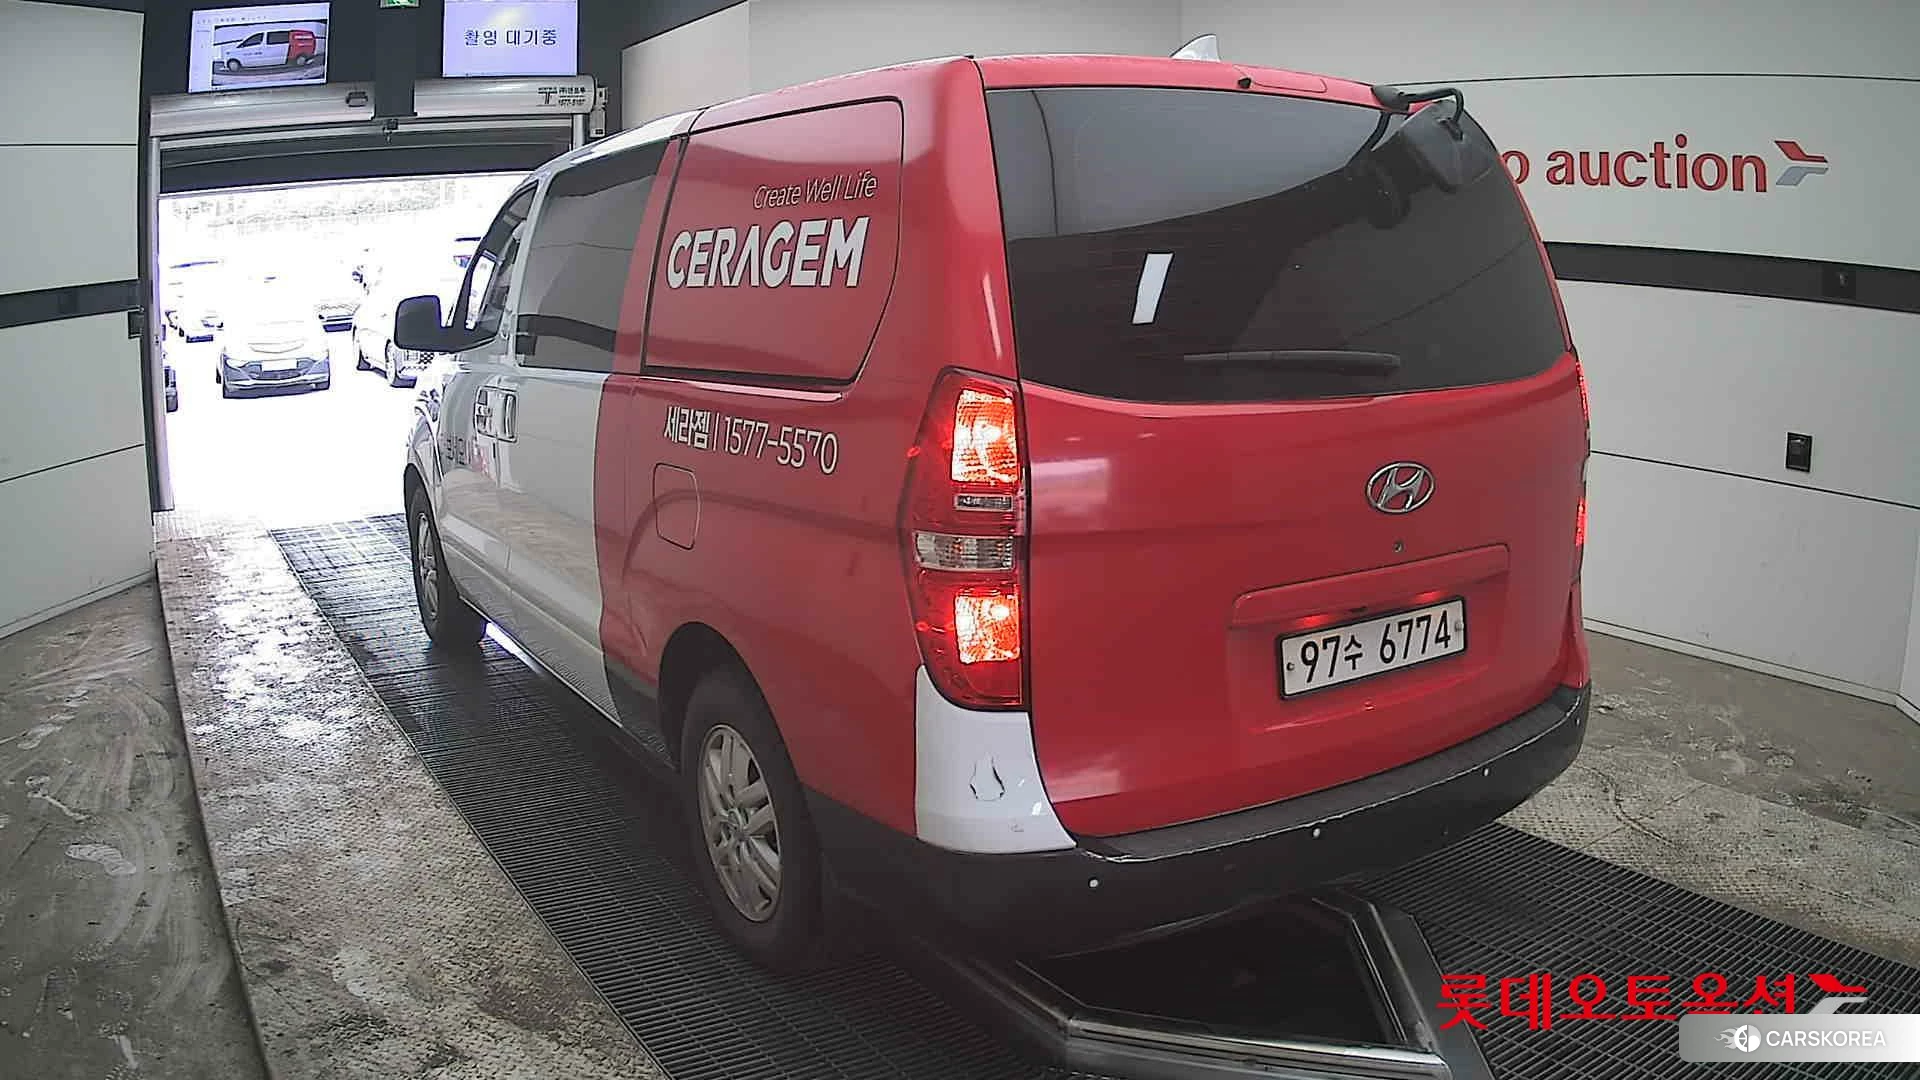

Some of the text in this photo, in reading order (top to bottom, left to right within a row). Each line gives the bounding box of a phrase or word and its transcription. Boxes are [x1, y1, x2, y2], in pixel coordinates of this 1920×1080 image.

[506, 29, 556, 46] 대기중
[753, 170, 877, 209] Create Well Life
[1546, 133, 1767, 193] auction
[667, 216, 870, 289] CERAGEM
[664, 405, 711, 450] 세라젬
[724, 416, 838, 475] 1577-5570
[1300, 609, 1451, 684] 97수 6774
